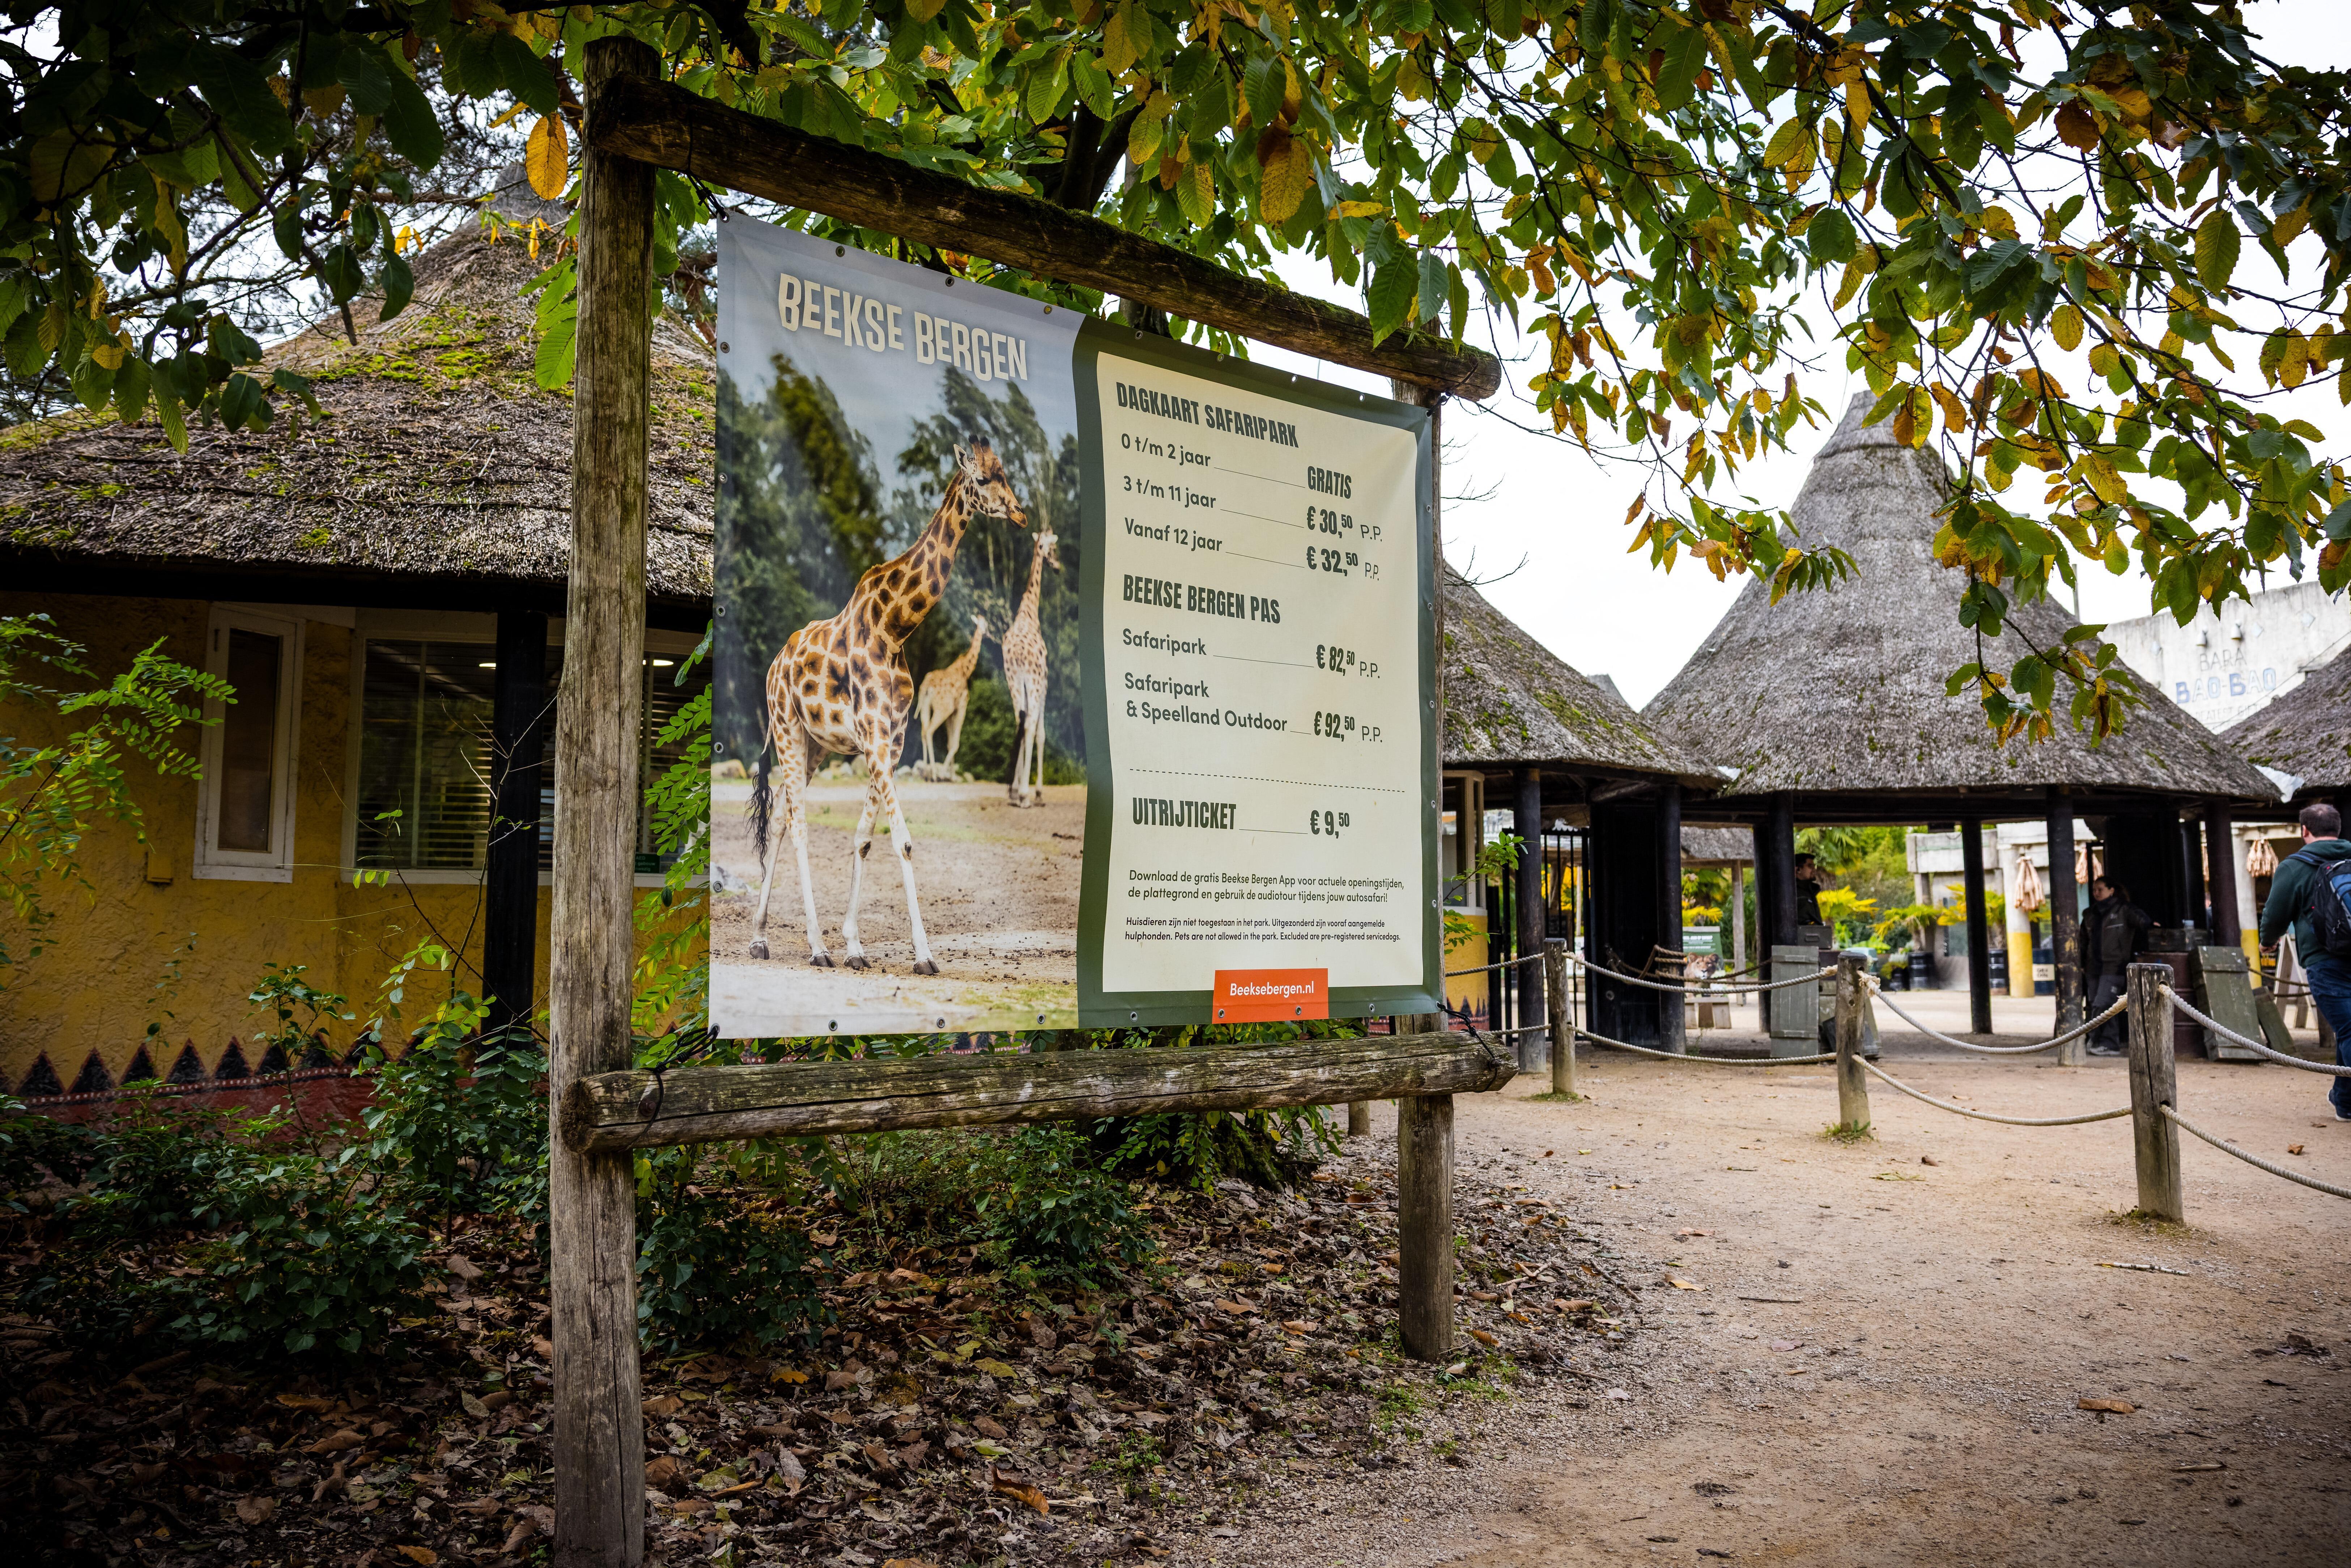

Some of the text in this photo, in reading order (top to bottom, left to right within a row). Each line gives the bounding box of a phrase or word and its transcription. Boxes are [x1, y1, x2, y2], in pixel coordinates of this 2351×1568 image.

[779, 273, 1026, 380] BEEKSE BERGEN
[1116, 382, 1298, 448] DAGKAART SAFARIPARK
[1122, 434, 1351, 499] 0 t/m 2 jaar GRATIS
[1124, 476, 1131, 491] 3
[1136, 479, 1164, 498] t/m
[1169, 485, 1181, 501] 11
[1185, 488, 1216, 508] jaar
[1307, 506, 1315, 530] €
[1360, 525, 1382, 541] P.P.
[1125, 518, 1170, 541] Vanaf
[1174, 528, 1188, 545] 12
[1191, 531, 1222, 551] jaar
[1306, 546, 1317, 569] €
[1365, 562, 1379, 581] P.P.
[1123, 574, 1280, 624] BEEKSE BERGEN PAS
[1123, 629, 1207, 656] Safaripark
[1316, 645, 1325, 669] €
[1360, 661, 1379, 678] P.P.
[1125, 672, 1209, 699] Safaripark
[2176, 668, 2276, 704] BAO-BAO
[1127, 700, 1137, 717] &
[1142, 702, 1220, 725] Speelland
[1225, 710, 1287, 731] Outdoor
[1314, 711, 1322, 735] €
[1362, 726, 1382, 742] P.P.
[1133, 798, 1236, 829] UITRIJTICKET
[1310, 810, 1320, 834] €
[1128, 887, 1140, 897] de
[1144, 887, 1198, 901] plattegrond
[1215, 889, 1245, 902] gebruik
[1247, 889, 1255, 899] de
[1258, 890, 1296, 900] audiotour
[1298, 891, 1325, 903] tijdens
[1327, 892, 1344, 904] jouw
[1347, 893, 1387, 902] autosafari!
[1130, 870, 1177, 881] Download
[1181, 871, 1191, 881] de
[1195, 873, 1219, 885] gratis
[1222, 873, 1249, 883] Beekse
[1252, 874, 1277, 887] Bergen
[1279, 875, 1295, 887] App
[1318, 876, 1346, 886] actuele
[1348, 878, 1403, 890] openingstijden,
[1125, 931, 1172, 942] hulphonden.
[1262, 932, 1278, 942] park.
[1321, 932, 1364, 942] pre-registered
[1366, 932, 1400, 942] servicedogs.
[1169, 918, 1181, 929] zijn
[1199, 919, 1234, 928] toegestaan
[1255, 918, 1270, 928] park.
[1272, 919, 1314, 929] Uitgezonderd
[1316, 919, 1326, 929] zijn
[1348, 920, 1385, 929] aangemelde
[1230, 981, 1314, 998] Beeksebergen.nl
